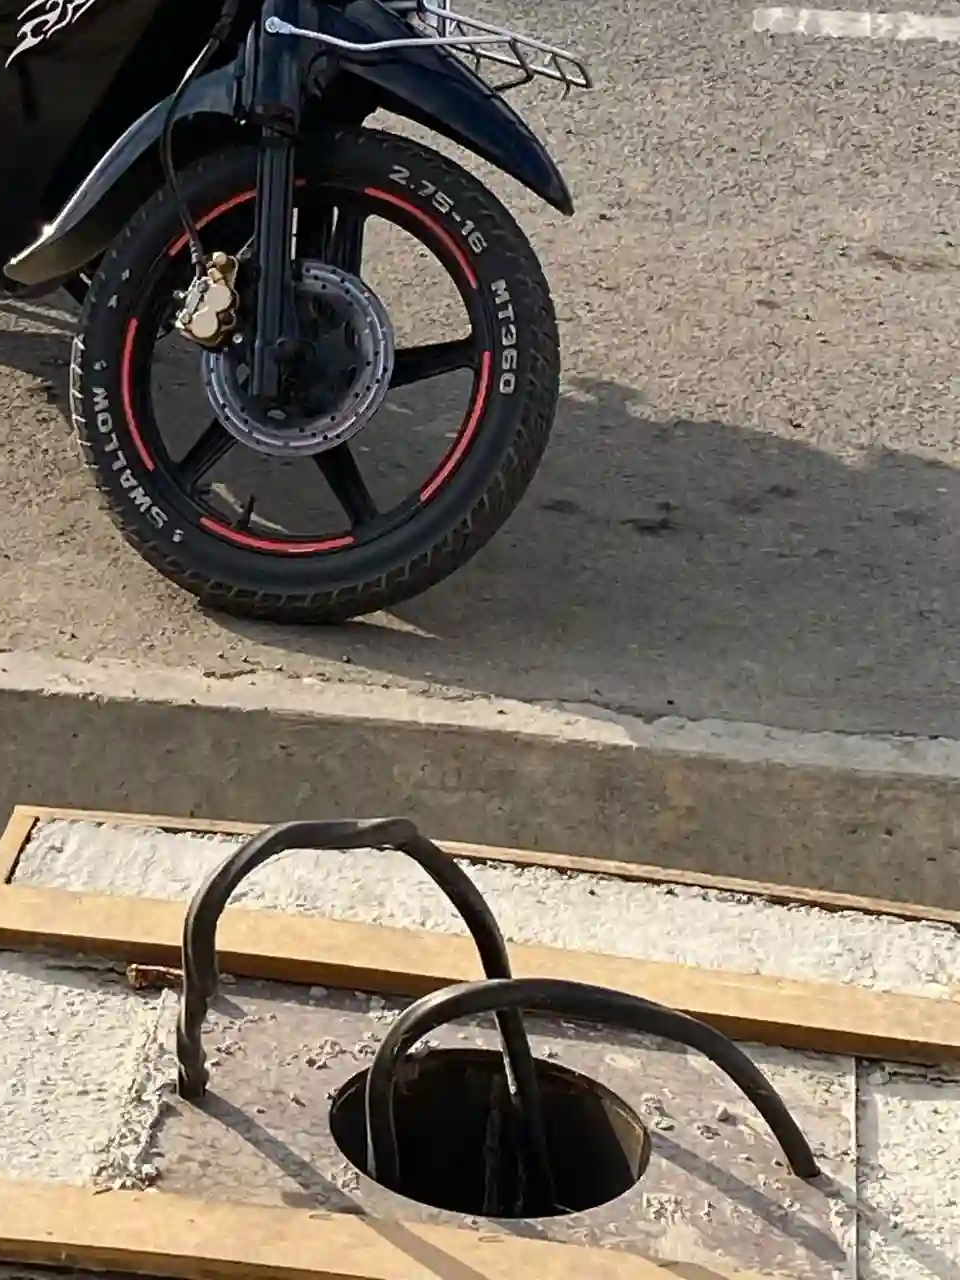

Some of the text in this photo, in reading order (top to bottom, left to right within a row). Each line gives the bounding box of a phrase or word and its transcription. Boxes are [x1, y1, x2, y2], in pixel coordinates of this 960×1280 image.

[388, 164, 488, 254] 2.75-16
[491, 278, 517, 395] MT360
[92, 386, 169, 529] SWALLOW
